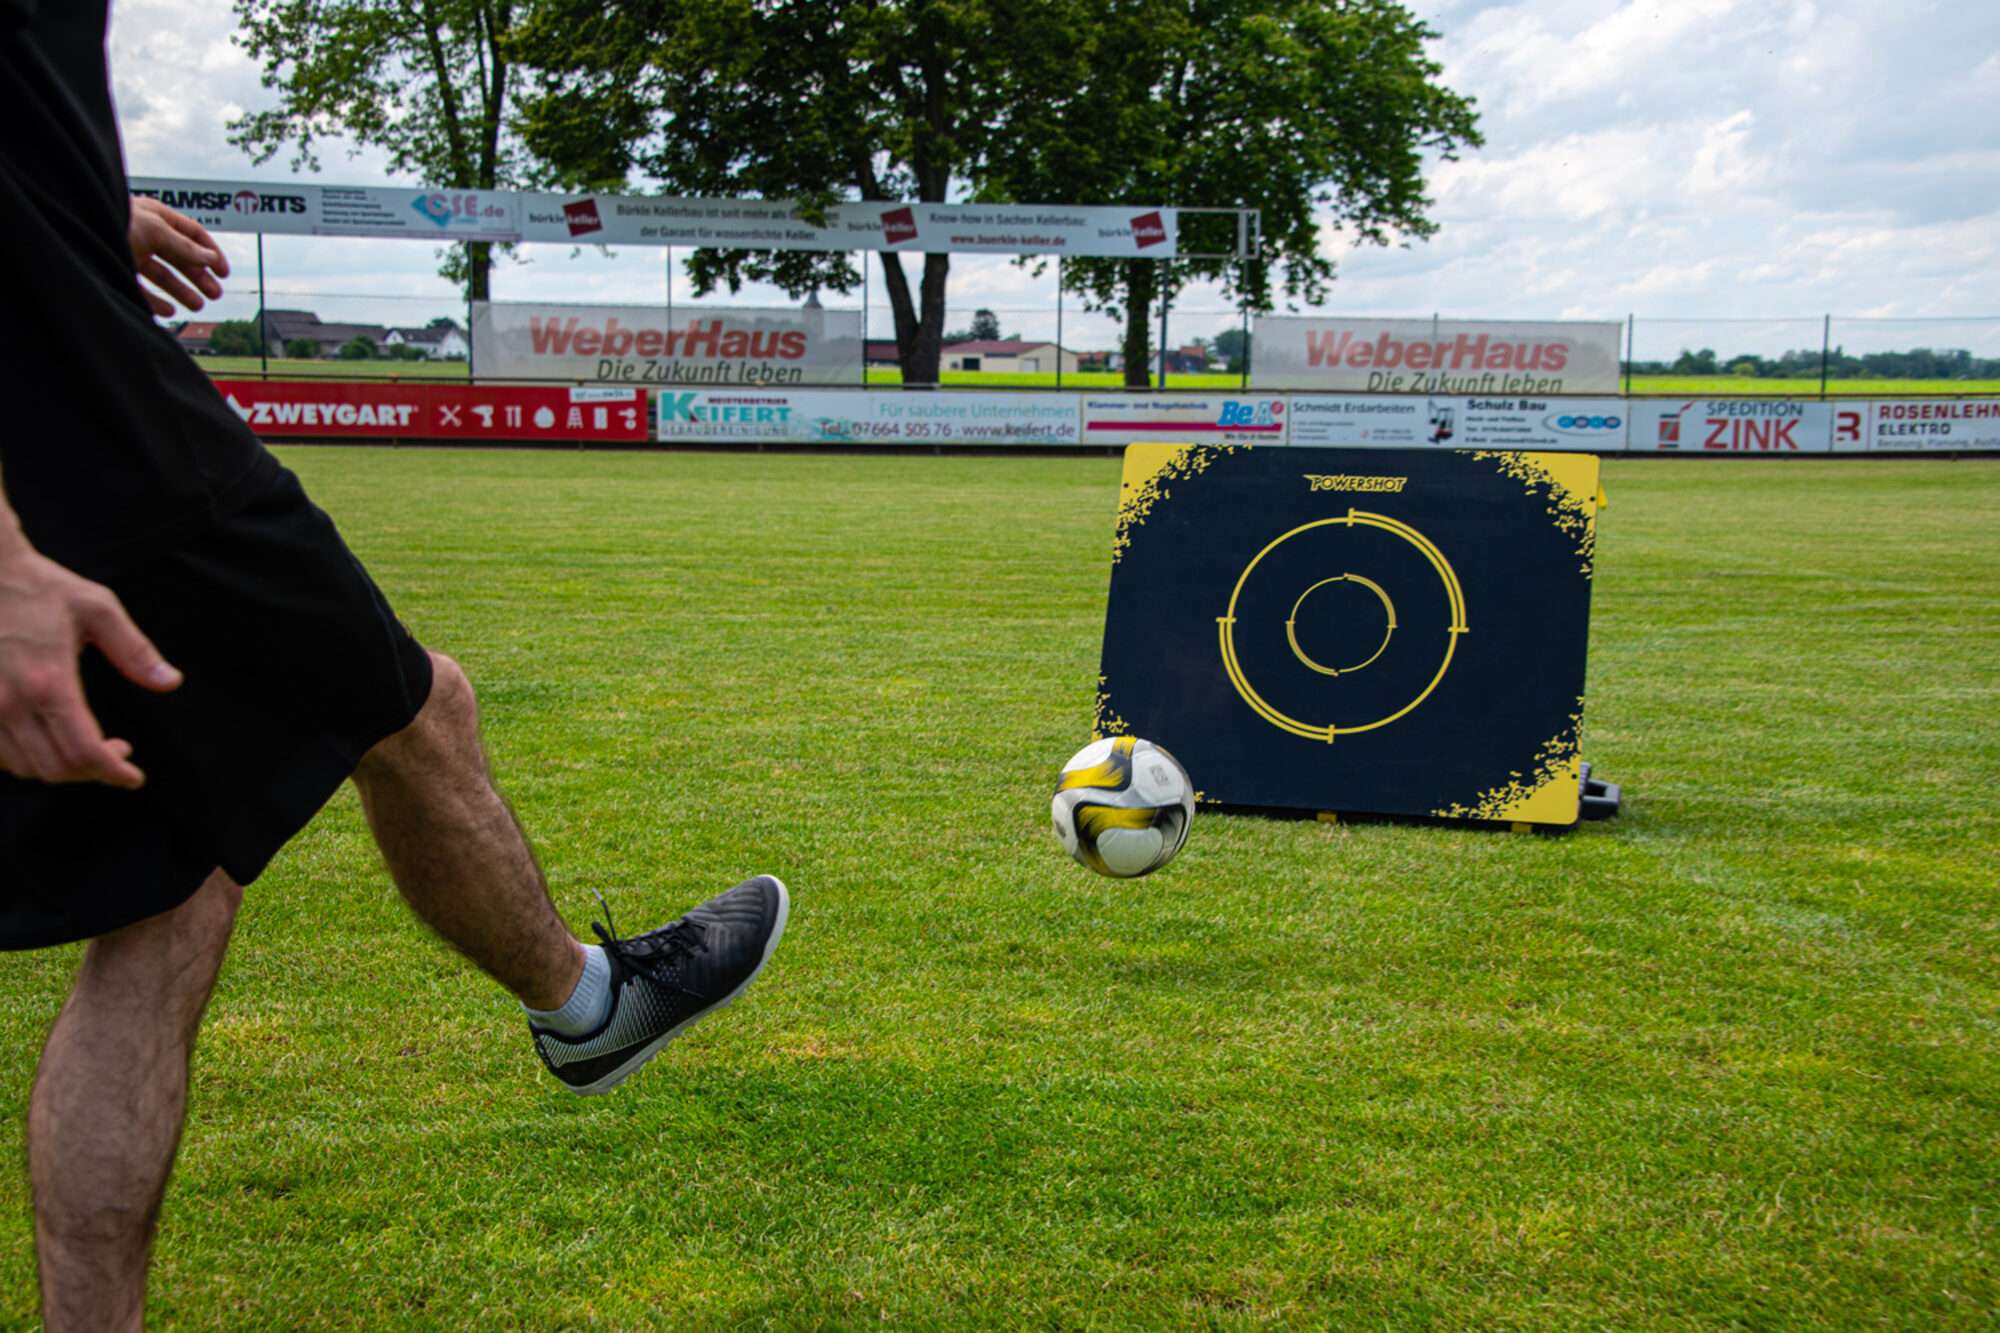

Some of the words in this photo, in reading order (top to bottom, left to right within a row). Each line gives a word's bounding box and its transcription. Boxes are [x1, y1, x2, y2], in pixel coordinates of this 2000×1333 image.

[529, 315, 807, 358] WeberHaus
[1305, 329, 1568, 371] WeberHaus
[597, 360, 635, 381] Die
[641, 360, 731, 382] Zukunft
[737, 361, 803, 384] leben
[1367, 371, 1404, 392] Die
[1409, 371, 1497, 393] Zukunft
[1502, 373, 1563, 394] leben
[253, 402, 413, 426] ZWEYGART
[661, 391, 792, 423] KEIFERT
[908, 401, 967, 417] saubere
[971, 402, 1075, 417] Unternehmen
[1467, 399, 1514, 411] Schulz
[1519, 400, 1546, 411] Bau
[1706, 401, 1804, 416] SPEDITION
[851, 421, 900, 437] 07664
[933, 422, 952, 438] 76
[1703, 418, 1800, 449] ZINK
[1877, 422, 1951, 436] ELEKTRO
[1303, 474, 1408, 492] POWERSHOT
